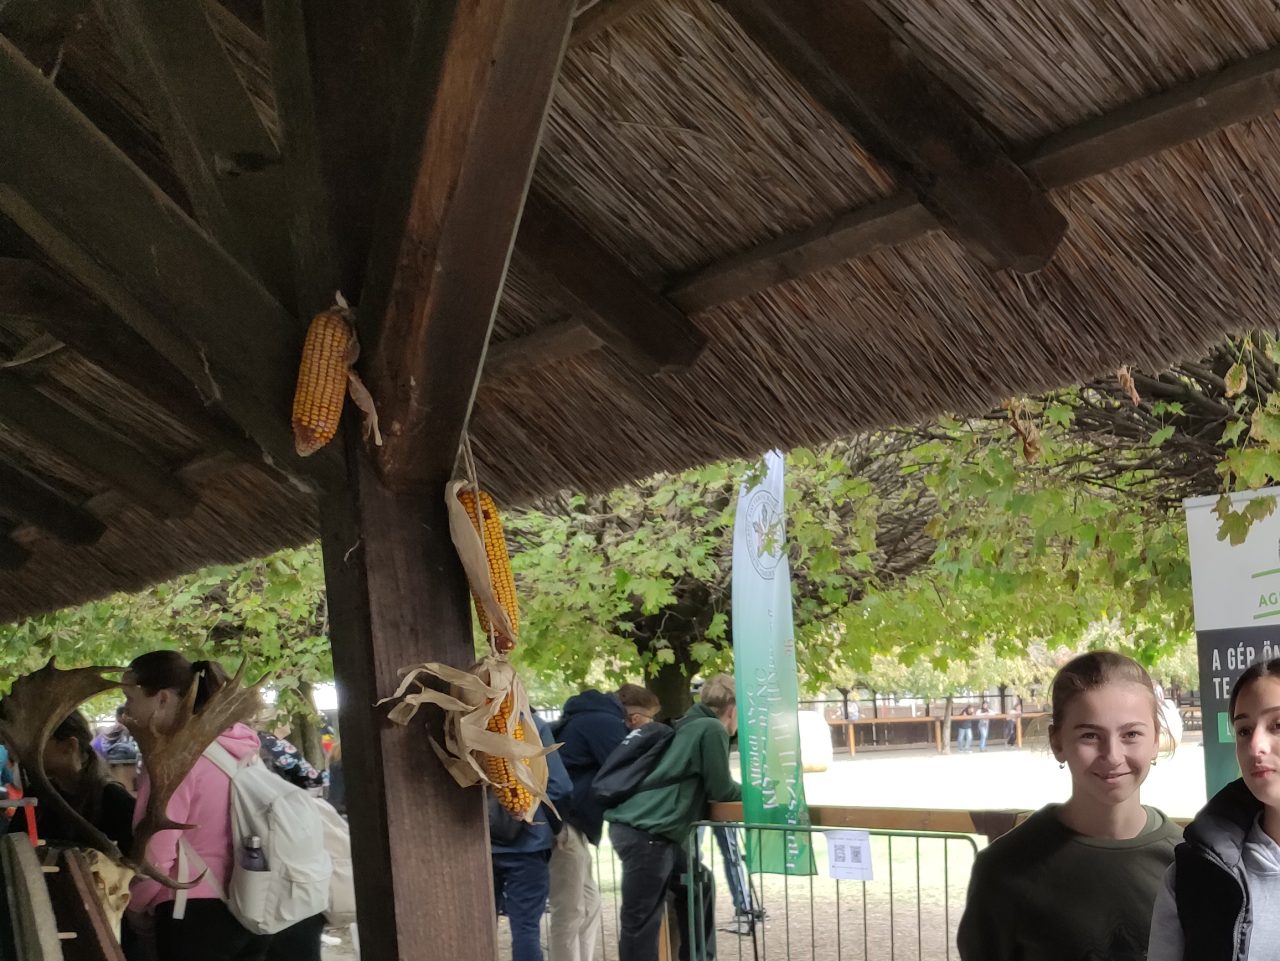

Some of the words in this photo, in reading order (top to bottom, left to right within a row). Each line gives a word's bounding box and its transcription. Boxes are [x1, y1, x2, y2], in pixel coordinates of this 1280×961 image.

[1212, 648, 1221, 671] A
[1227, 641, 1255, 670] GÉP
[1212, 677, 1230, 699] TE
